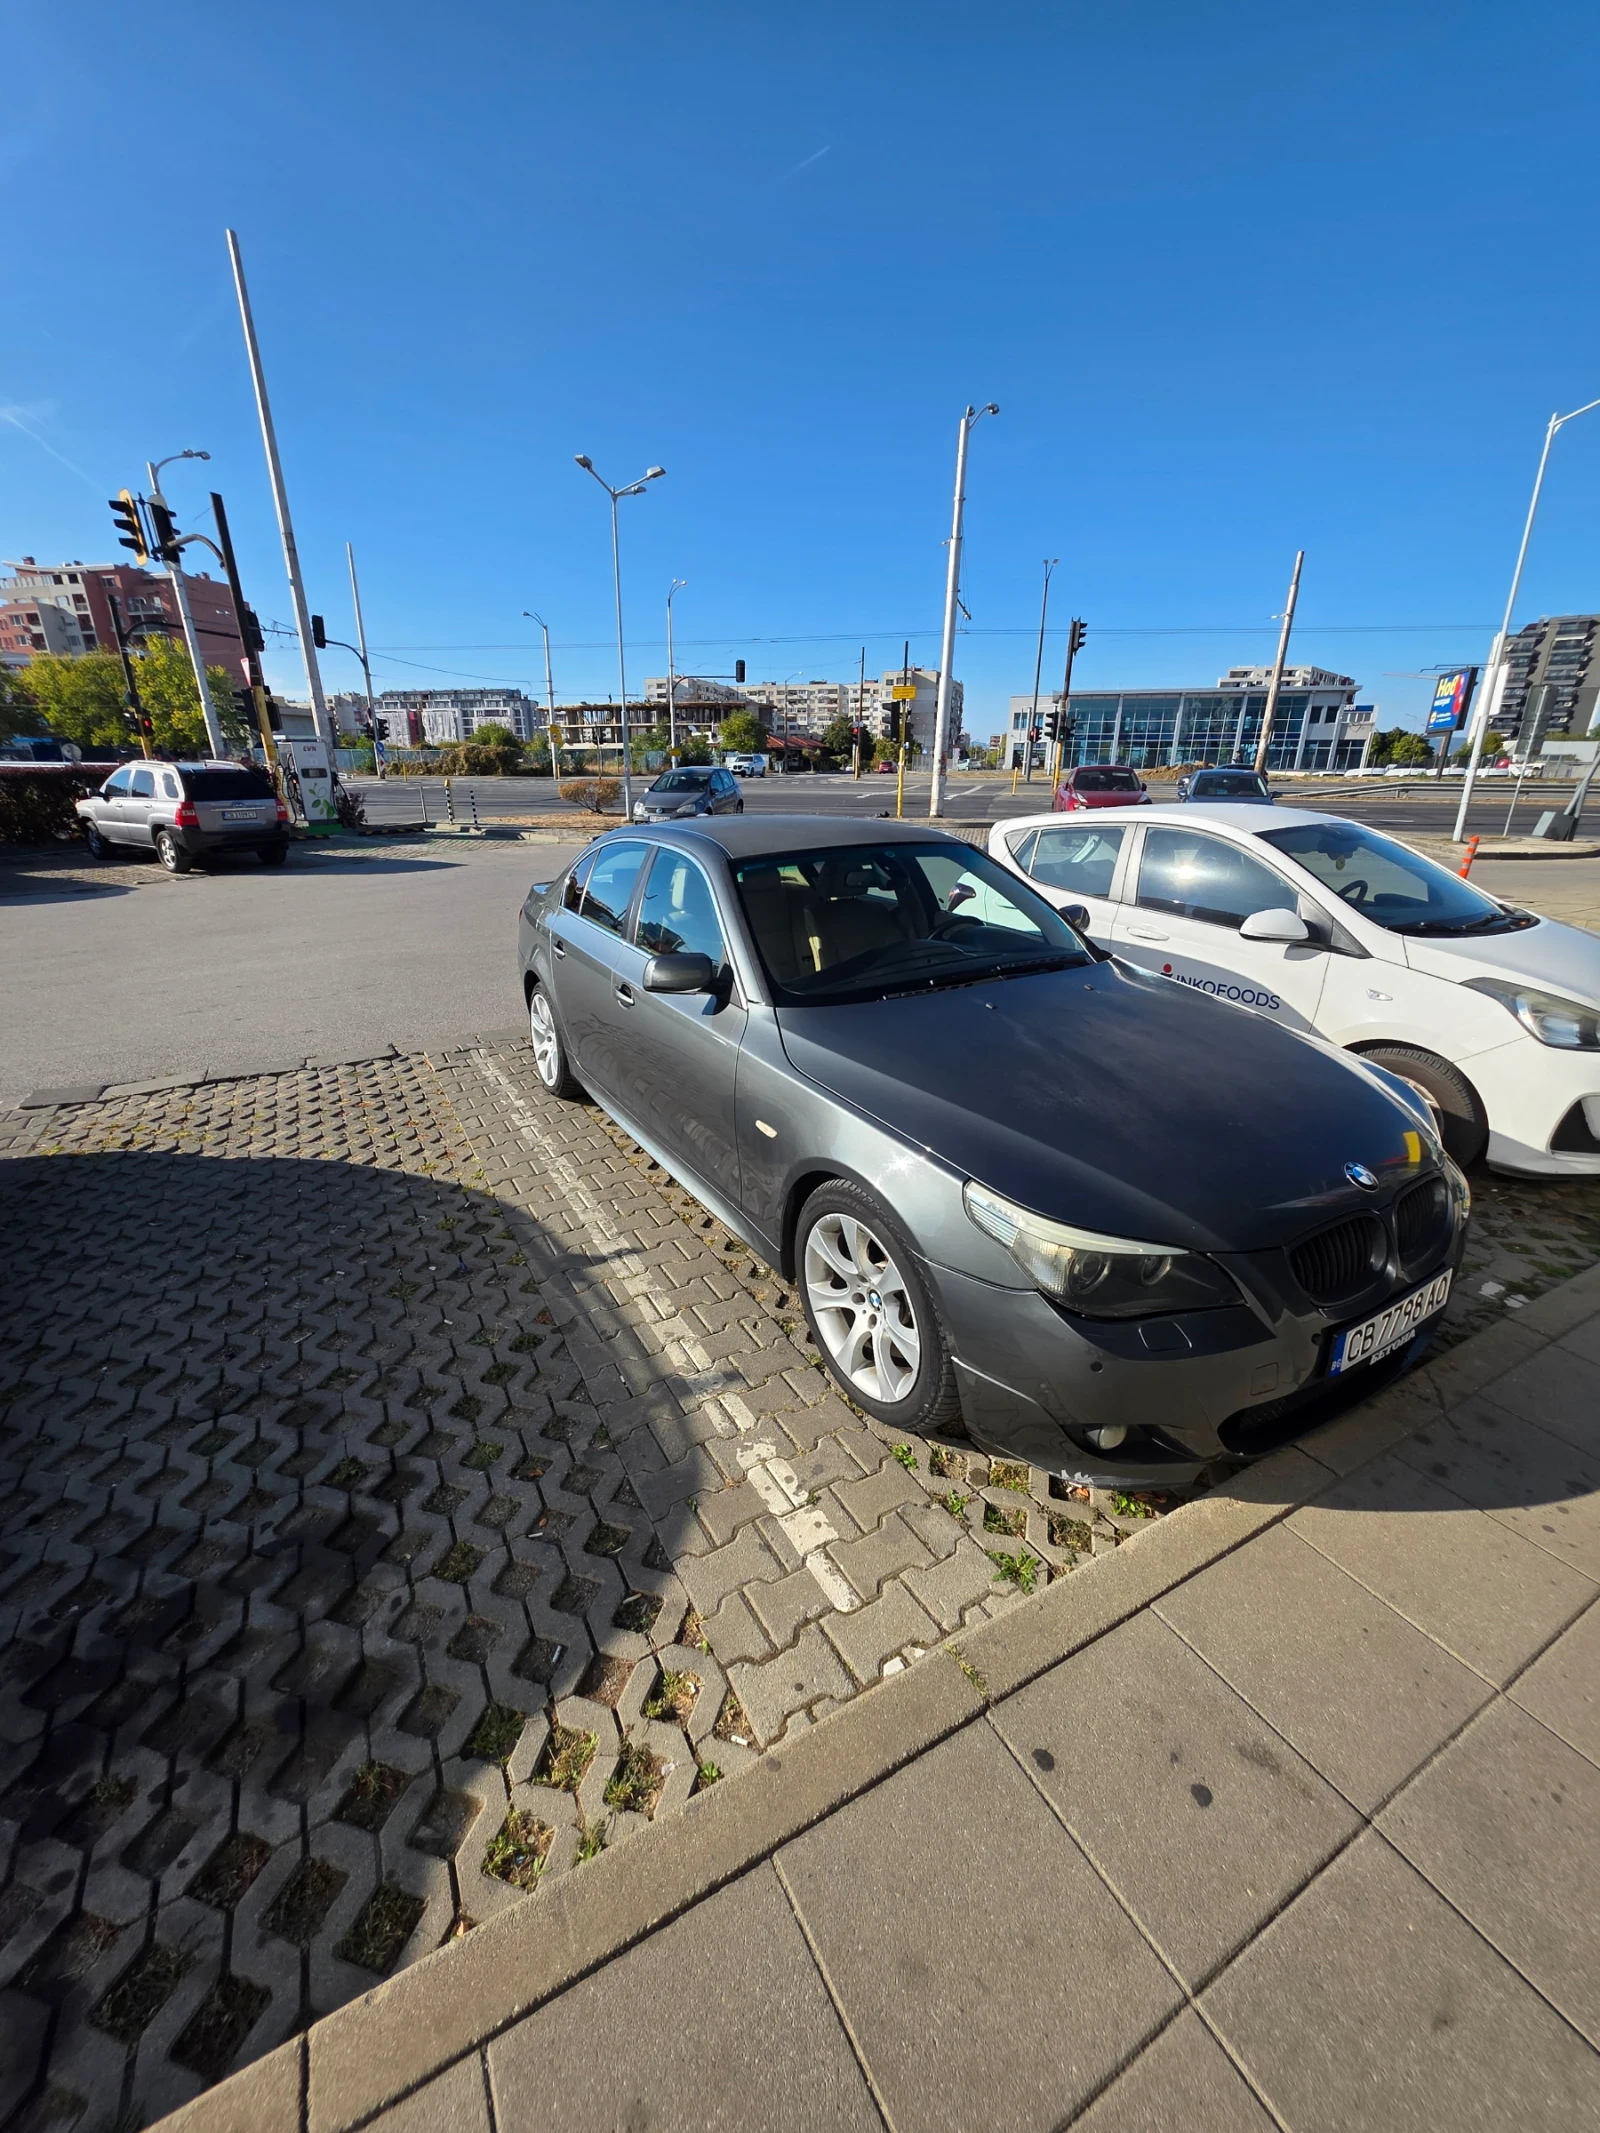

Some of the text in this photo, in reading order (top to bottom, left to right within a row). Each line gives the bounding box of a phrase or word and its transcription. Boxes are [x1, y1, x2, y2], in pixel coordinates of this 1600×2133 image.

[1347, 1276, 1448, 1362] CB 7798 AO
[1331, 1358, 1342, 1371] BG
